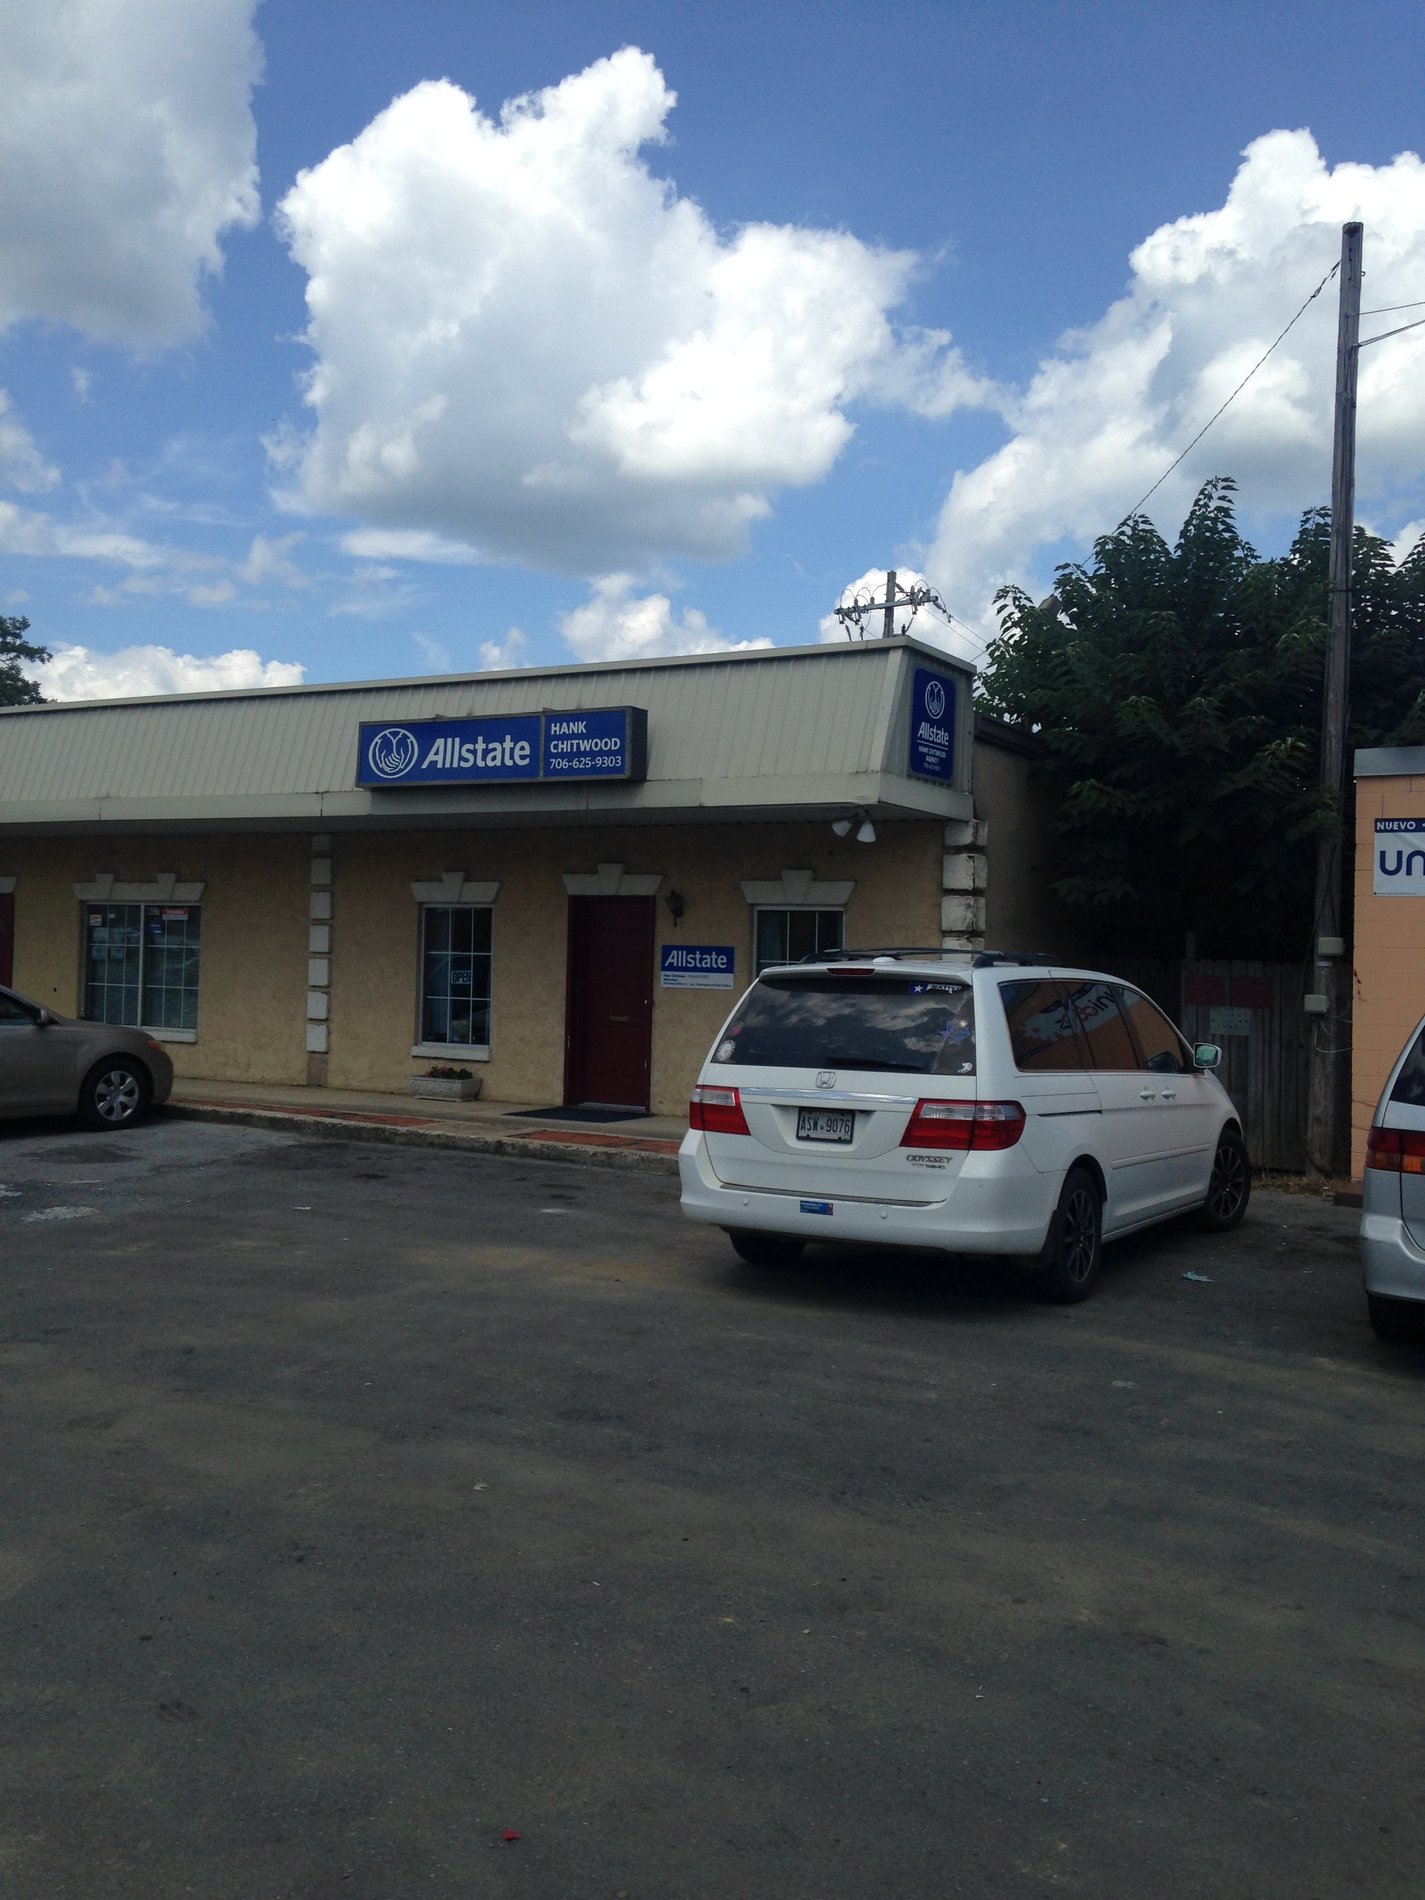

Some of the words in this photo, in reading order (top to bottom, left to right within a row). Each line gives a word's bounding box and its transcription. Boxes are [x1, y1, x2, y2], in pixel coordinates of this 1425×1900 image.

[551, 720, 587, 735] HANK
[917, 721, 949, 745] Allstate
[421, 734, 531, 769] Allstate
[550, 738, 621, 753] CHITWOOD
[549, 755, 622, 769] 706-625-9303
[1376, 821, 1416, 830] NUEVO
[665, 950, 728, 969] Allstate
[800, 1116, 819, 1131] ASW
[826, 1118, 850, 1134] 9076
[906, 1155, 953, 1164] ODYSSEY
